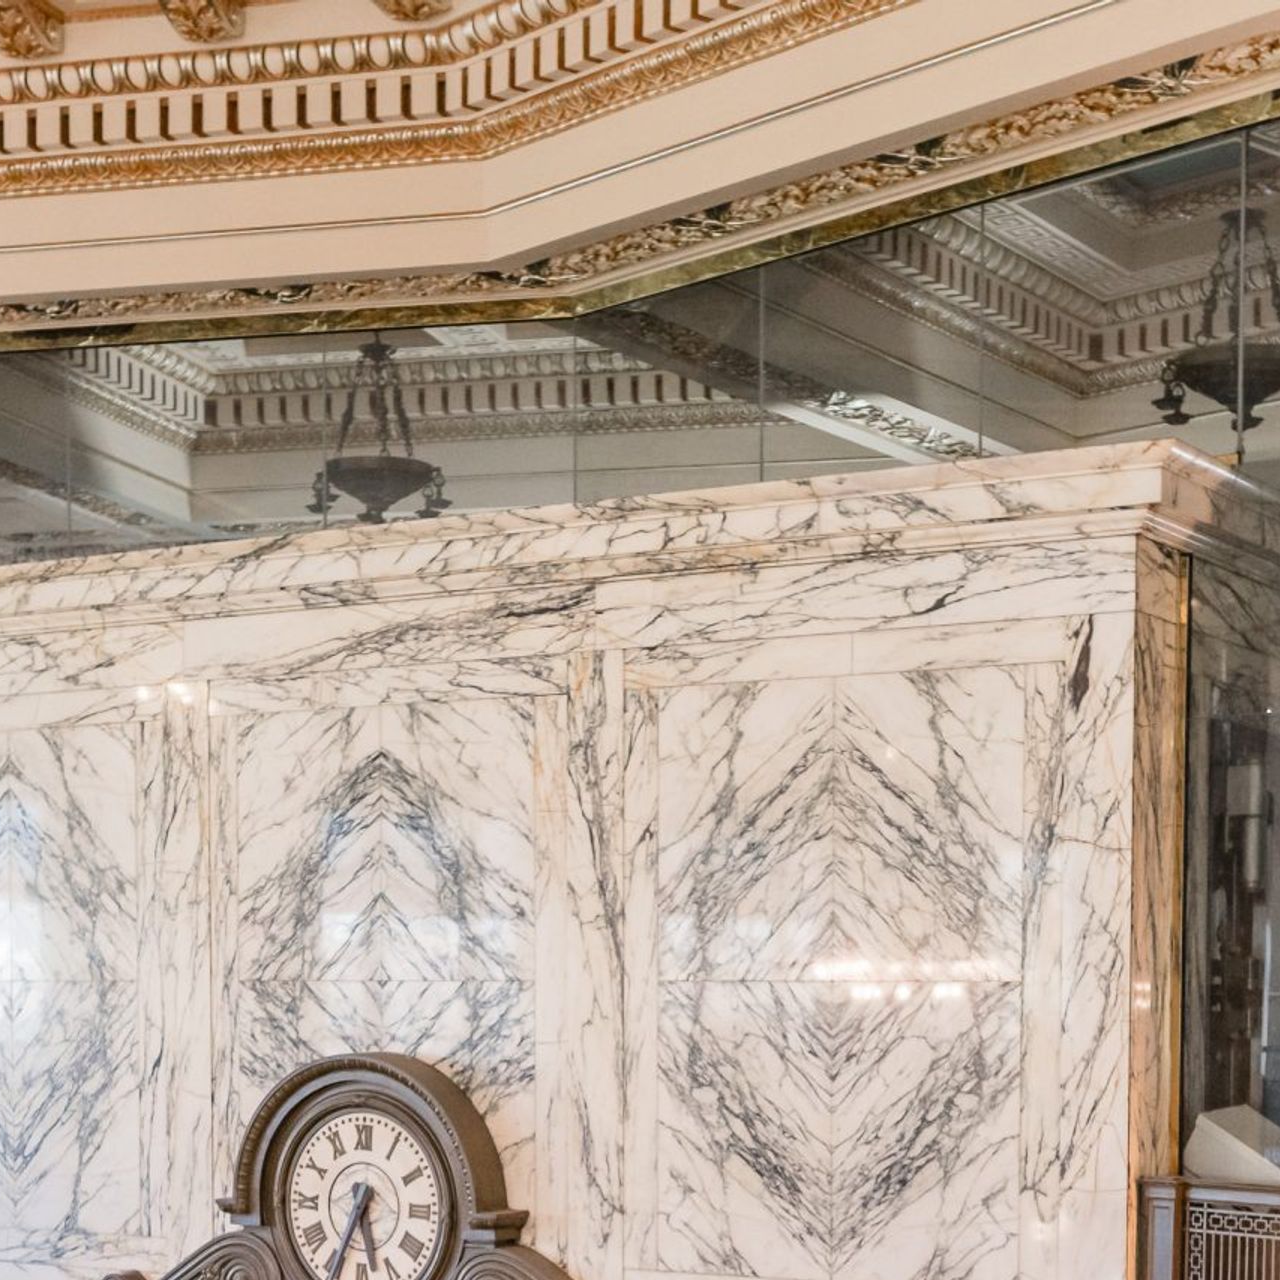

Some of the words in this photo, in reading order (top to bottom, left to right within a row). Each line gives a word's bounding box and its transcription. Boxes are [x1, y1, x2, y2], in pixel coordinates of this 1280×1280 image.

[326, 1130, 346, 1160] XI
[354, 1124, 373, 1151] XII
[305, 1156, 328, 1180] X
[401, 1165, 424, 1187] II
[409, 1203, 431, 1221] III
